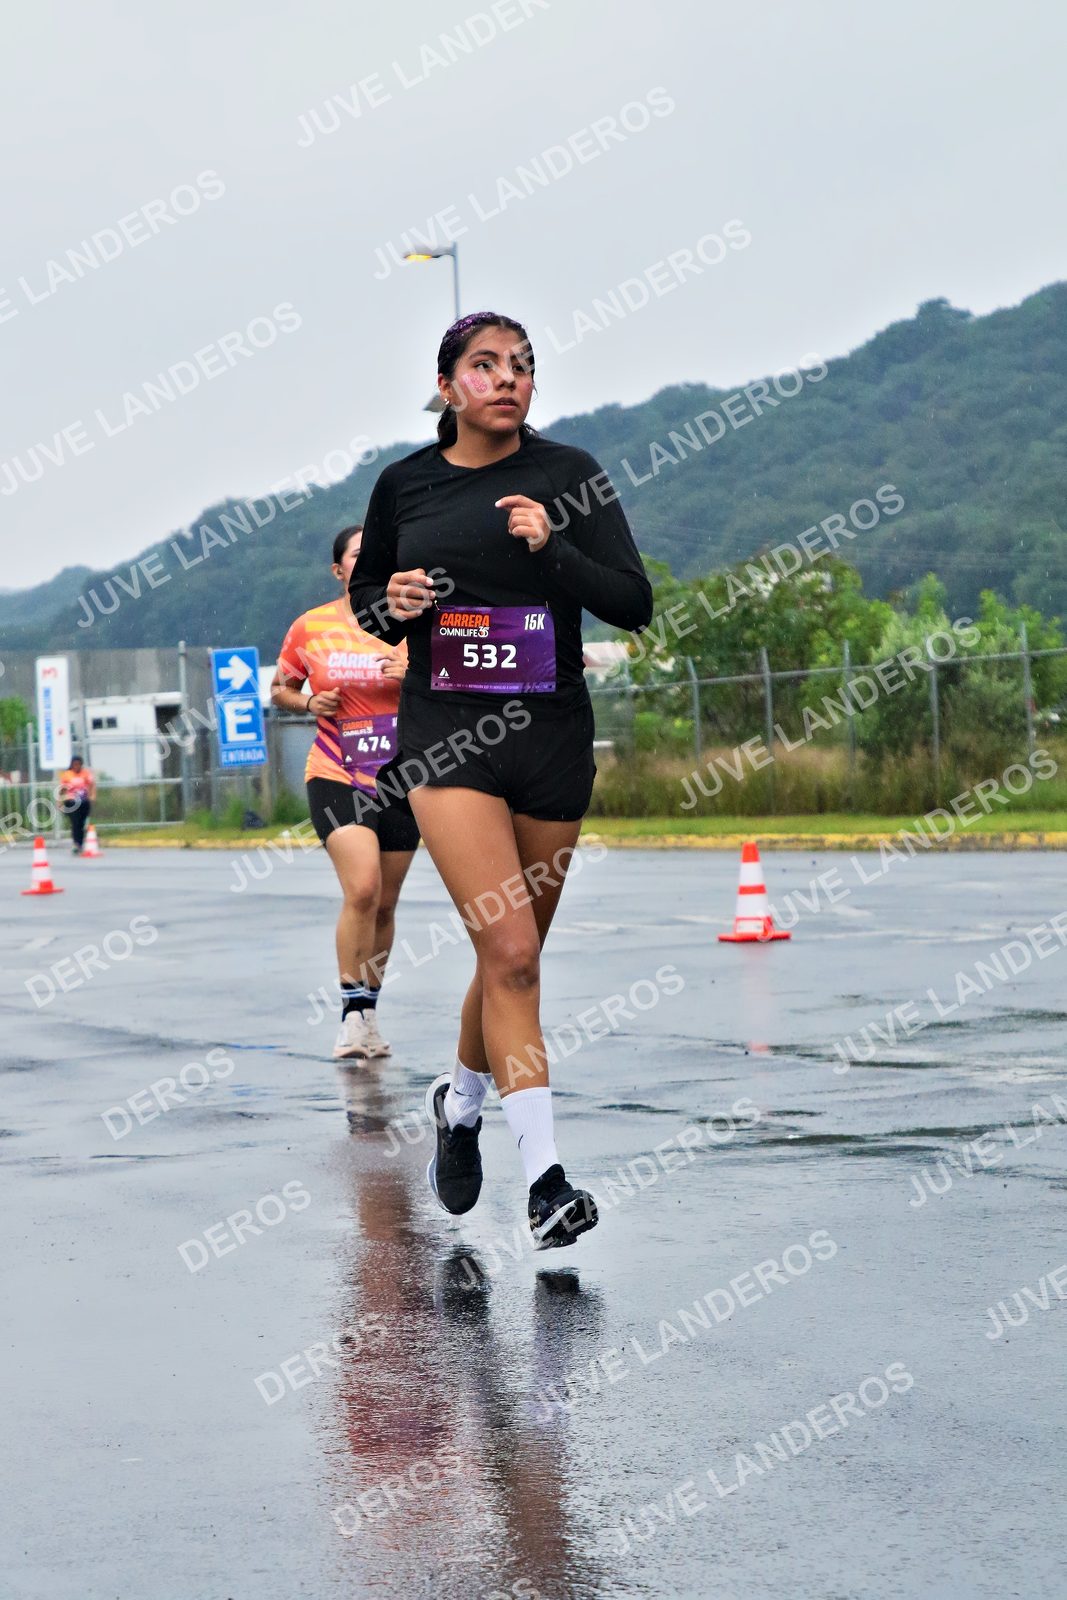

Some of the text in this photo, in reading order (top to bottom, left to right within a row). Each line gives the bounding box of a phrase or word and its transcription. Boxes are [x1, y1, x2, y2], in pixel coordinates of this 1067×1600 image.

[440, 613, 490, 627] CARRERA
[328, 651, 381, 668] CARRE
[463, 643, 517, 669] 532
[224, 700, 257, 742] E
[357, 735, 391, 752] 474
[221, 748, 265, 763] ENTRADA
